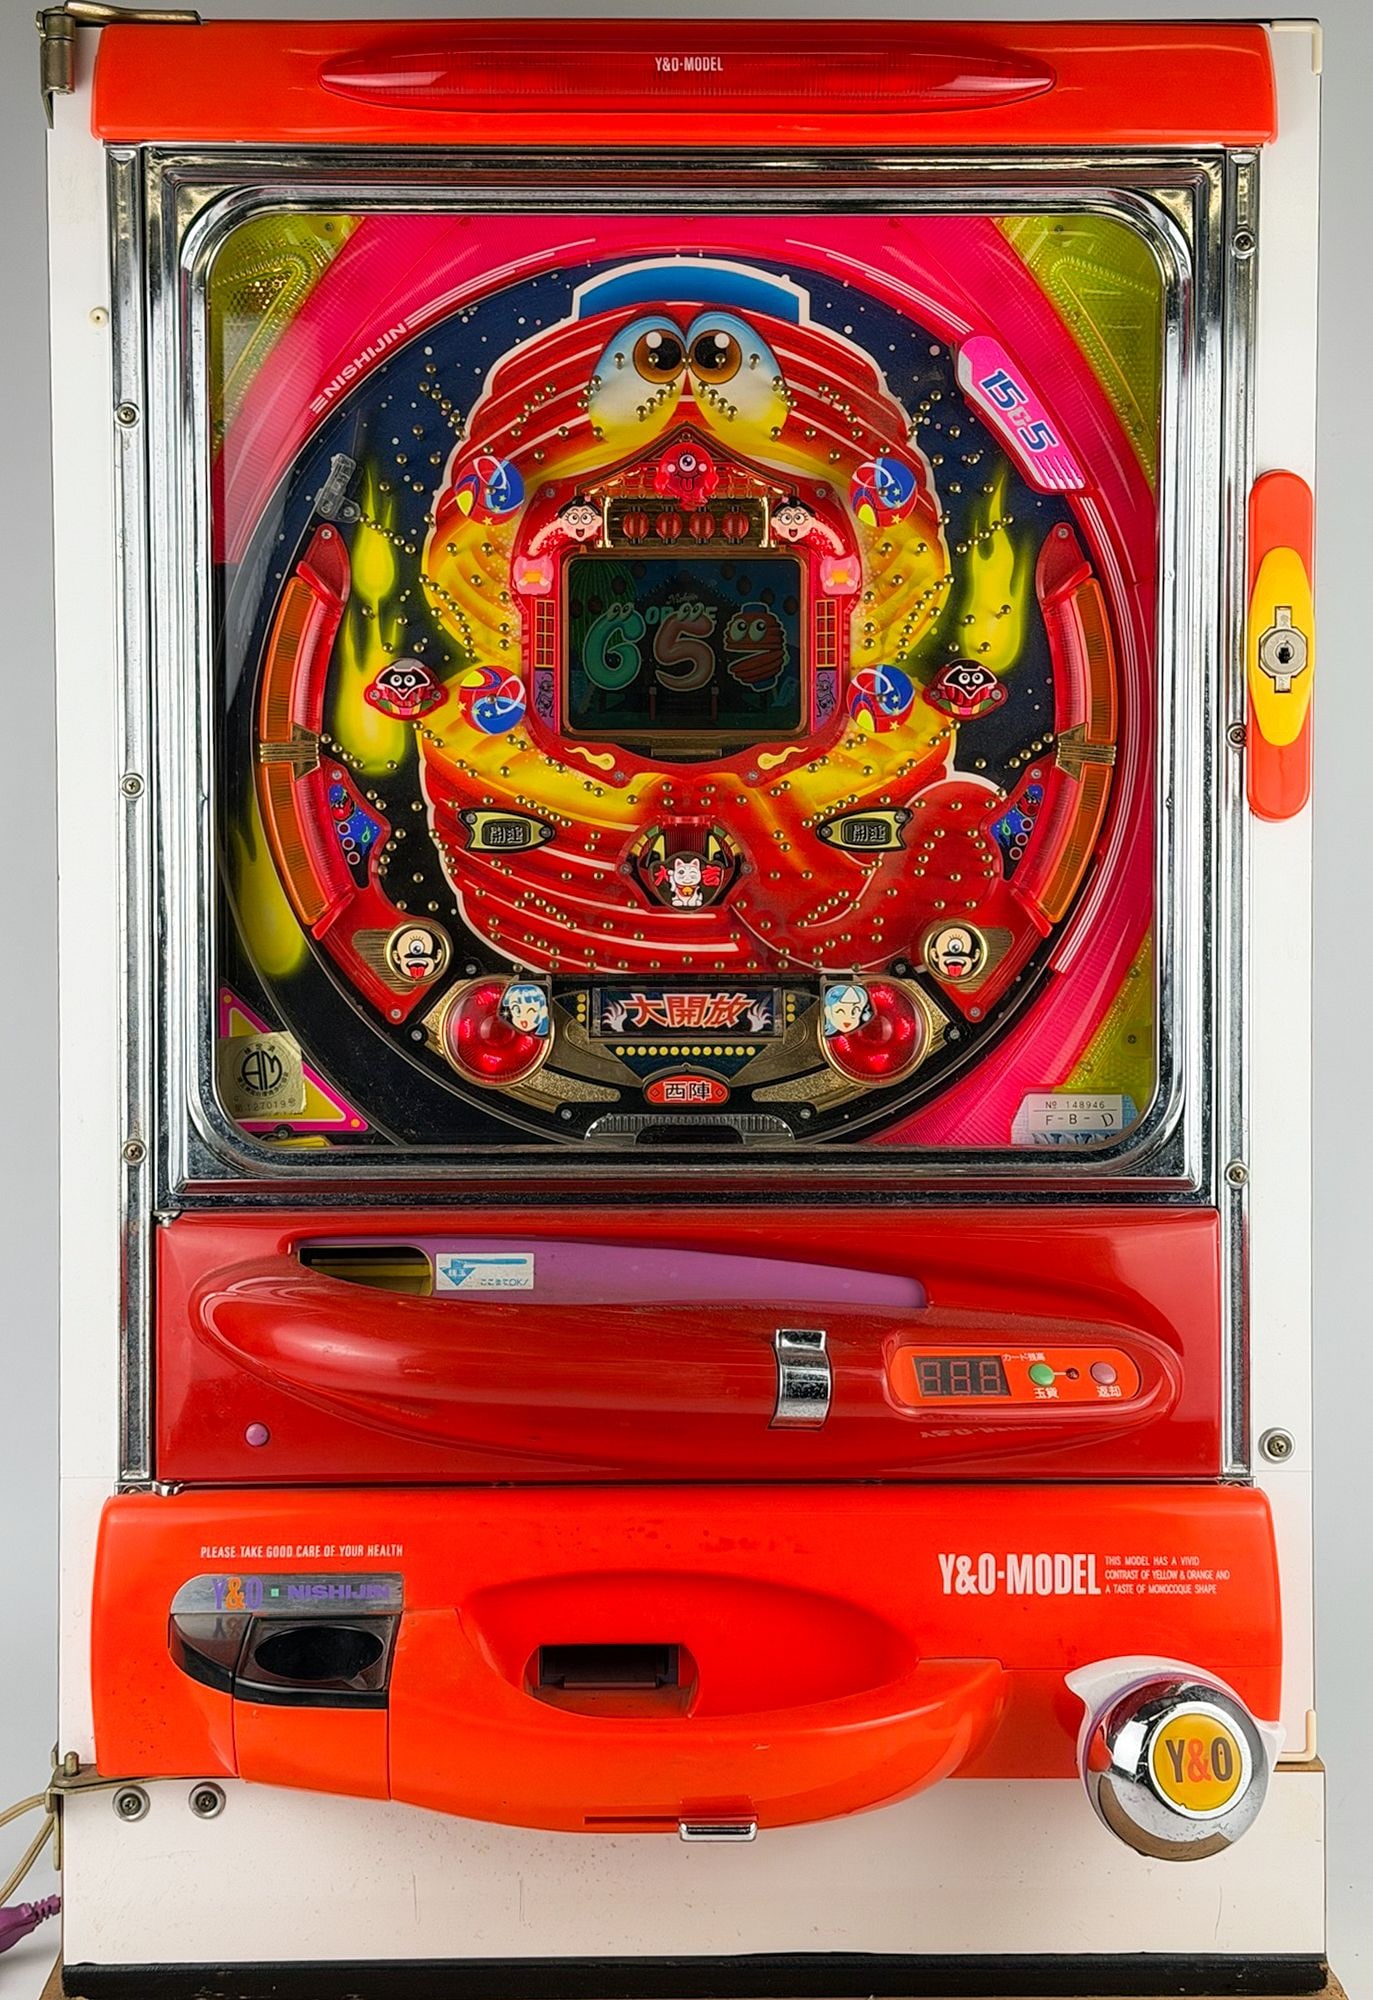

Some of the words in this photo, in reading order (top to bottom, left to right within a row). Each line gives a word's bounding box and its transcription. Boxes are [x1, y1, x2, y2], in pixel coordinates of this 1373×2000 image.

[323, 322, 407, 399] NISHIJIN
[624, 992, 756, 1029] 大開放
[664, 1081, 712, 1101] 西陣
[1065, 1101, 1106, 1109] 148946
[1096, 1385, 1122, 1399] 返却
[200, 1545, 236, 1559] PLEASE
[240, 1545, 263, 1558] TAKE
[266, 1545, 293, 1558] GOOD
[296, 1544, 321, 1558] CARE
[323, 1544, 336, 1557] OF
[340, 1544, 364, 1557] YOUR
[367, 1543, 403, 1557] HEALTH
[1104, 1555, 1121, 1566] THIS
[1124, 1555, 1150, 1566] MODEL
[1153, 1555, 1168, 1566] HAS
[1170, 1555, 1178, 1566] A
[1180, 1555, 1200, 1566] VIVID
[1104, 1569, 1139, 1580] CONTRAST
[1140, 1569, 1150, 1580] OF
[1151, 1569, 1178, 1580] YELLOW
[1179, 1569, 1186, 1580] &
[1186, 1569, 1214, 1580] ORANGE
[1215, 1569, 1231, 1580] AND
[211, 1576, 264, 1611] Y&O
[286, 1584, 391, 1601] NISHIJIN
[1104, 1583, 1112, 1594] A
[1113, 1583, 1134, 1594] TASTE
[1136, 1583, 1147, 1594] OF
[1148, 1583, 1193, 1595] MONOCOQUE
[1194, 1583, 1217, 1594] SHAPE
[1164, 1736, 1233, 1784] Y&O
